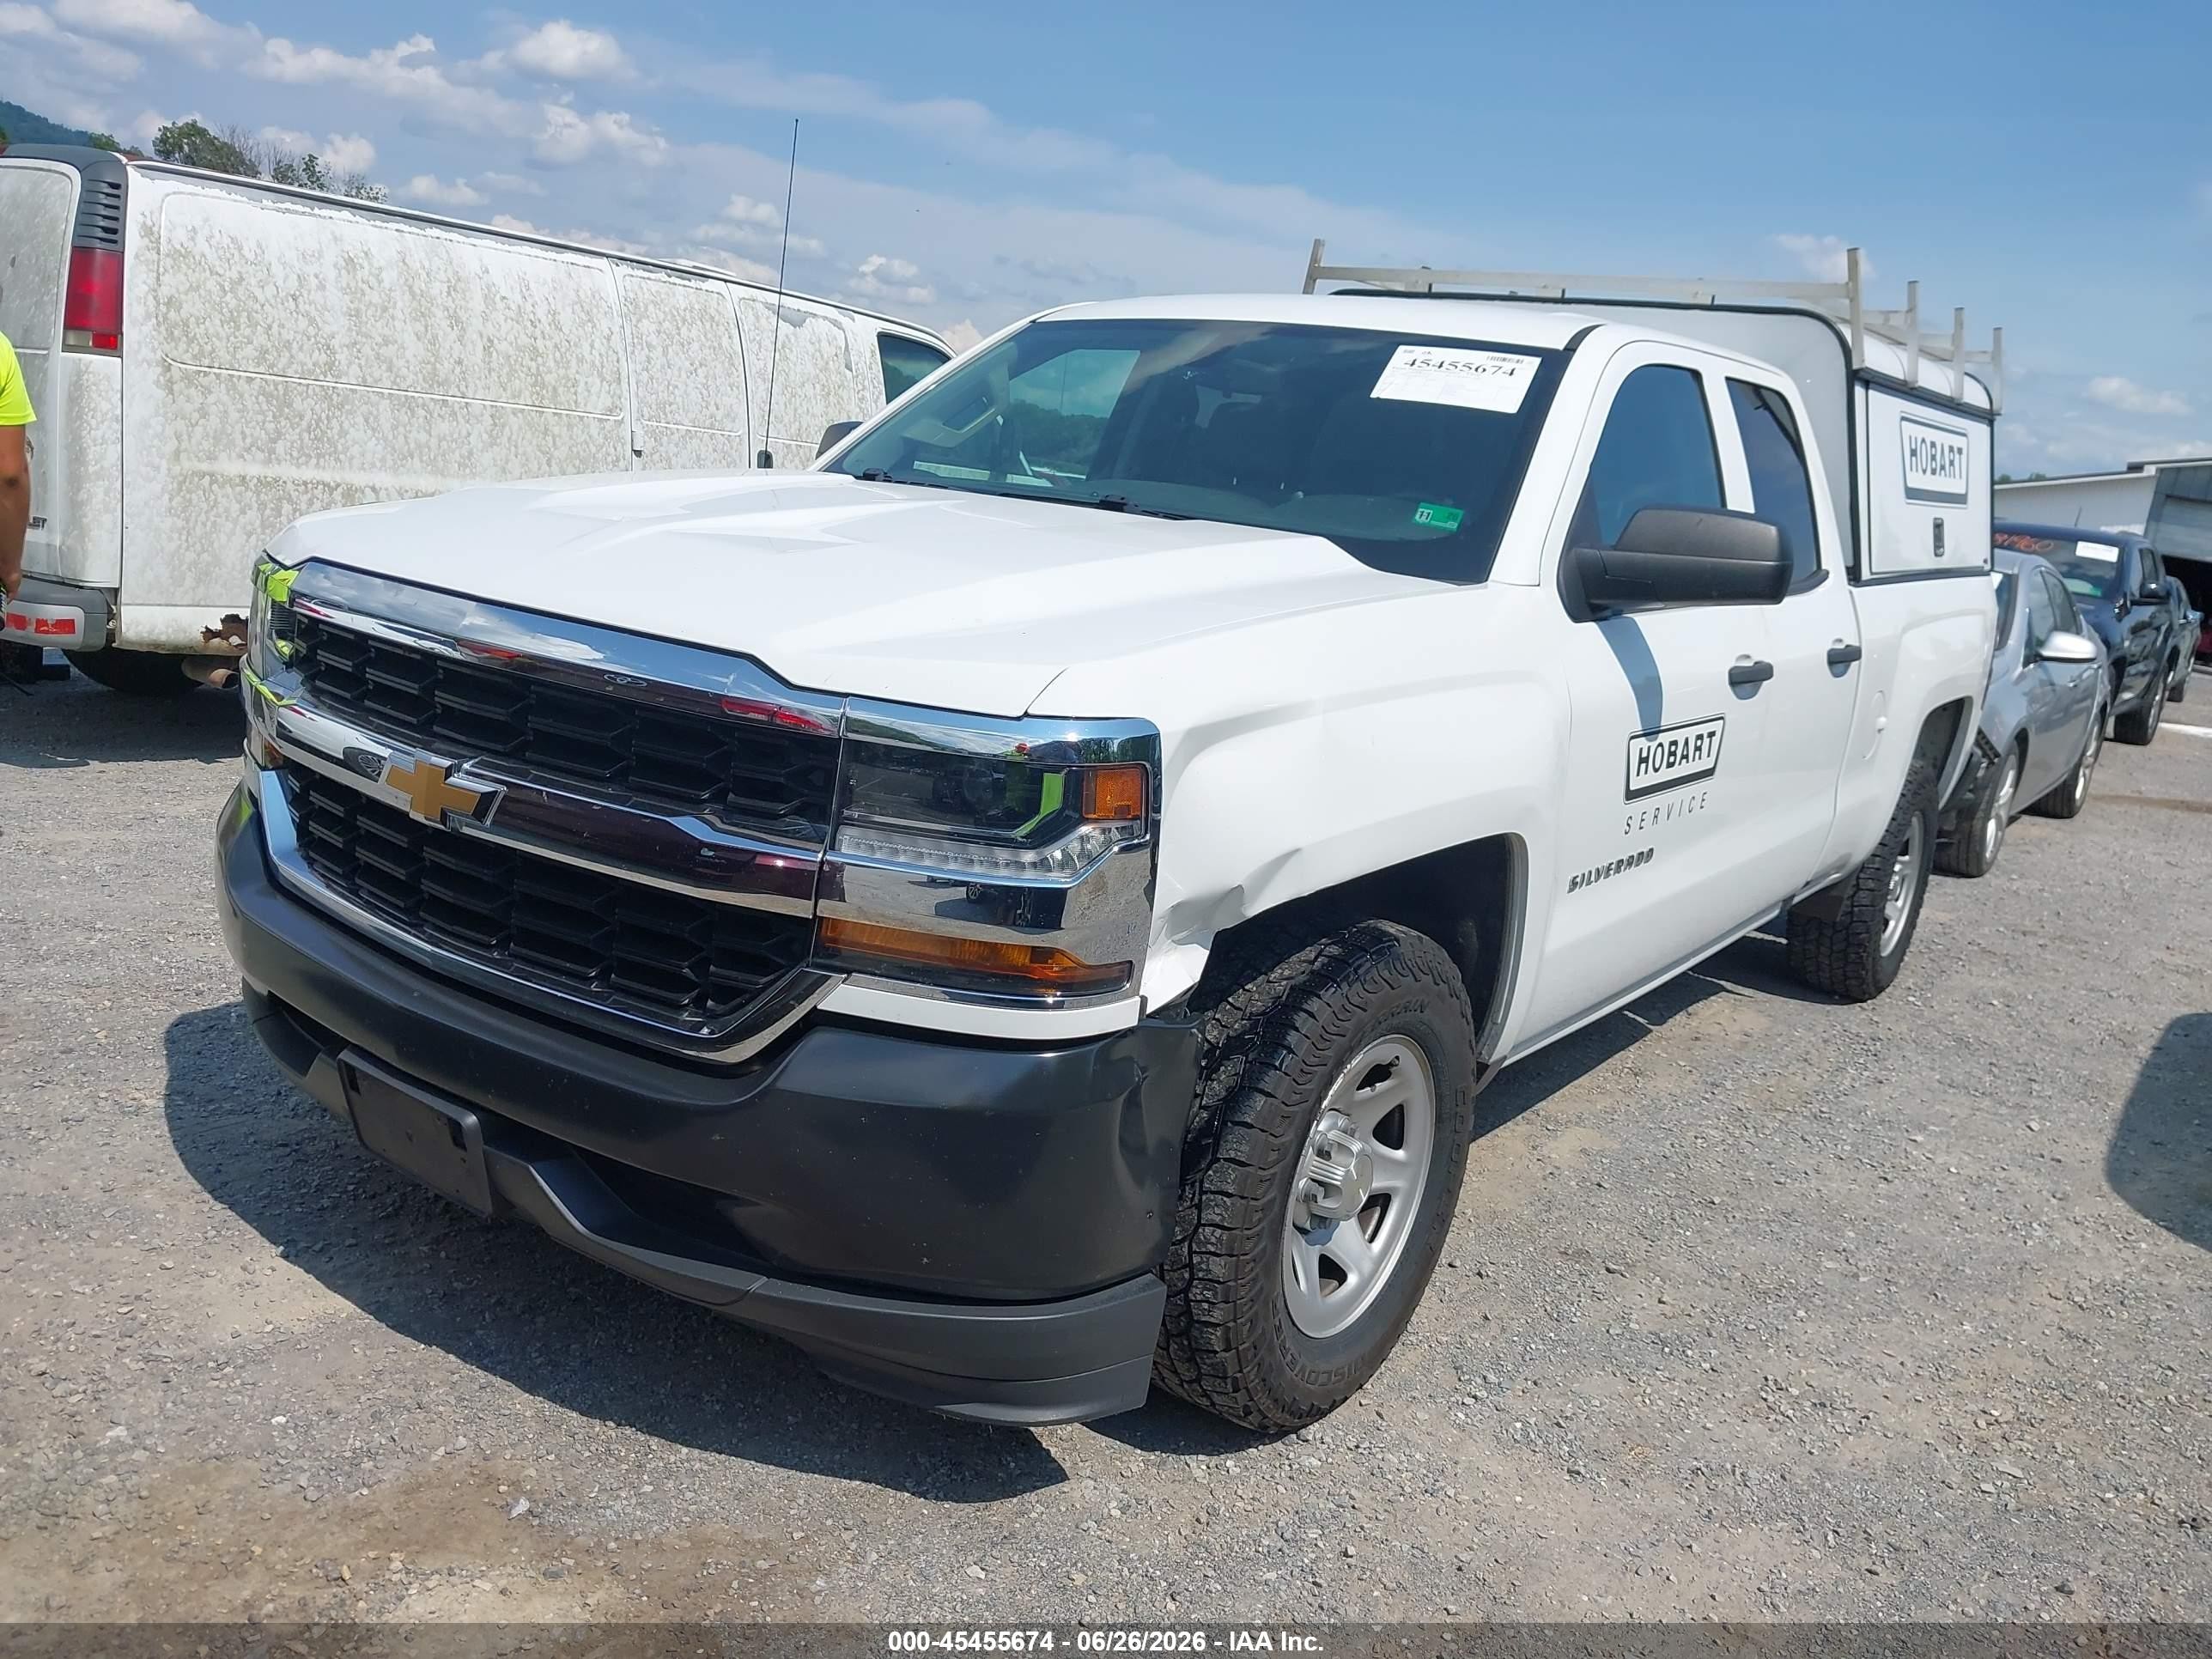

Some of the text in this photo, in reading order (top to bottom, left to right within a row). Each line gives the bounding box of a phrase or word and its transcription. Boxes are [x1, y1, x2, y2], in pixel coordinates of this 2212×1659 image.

[1404, 358, 1516, 377] 45455674
[1908, 434, 1963, 479] HOBART
[1636, 731, 1717, 777] HOBART
[1624, 792, 1707, 836] SERVICE
[1566, 847, 1654, 894] SILVERADO
